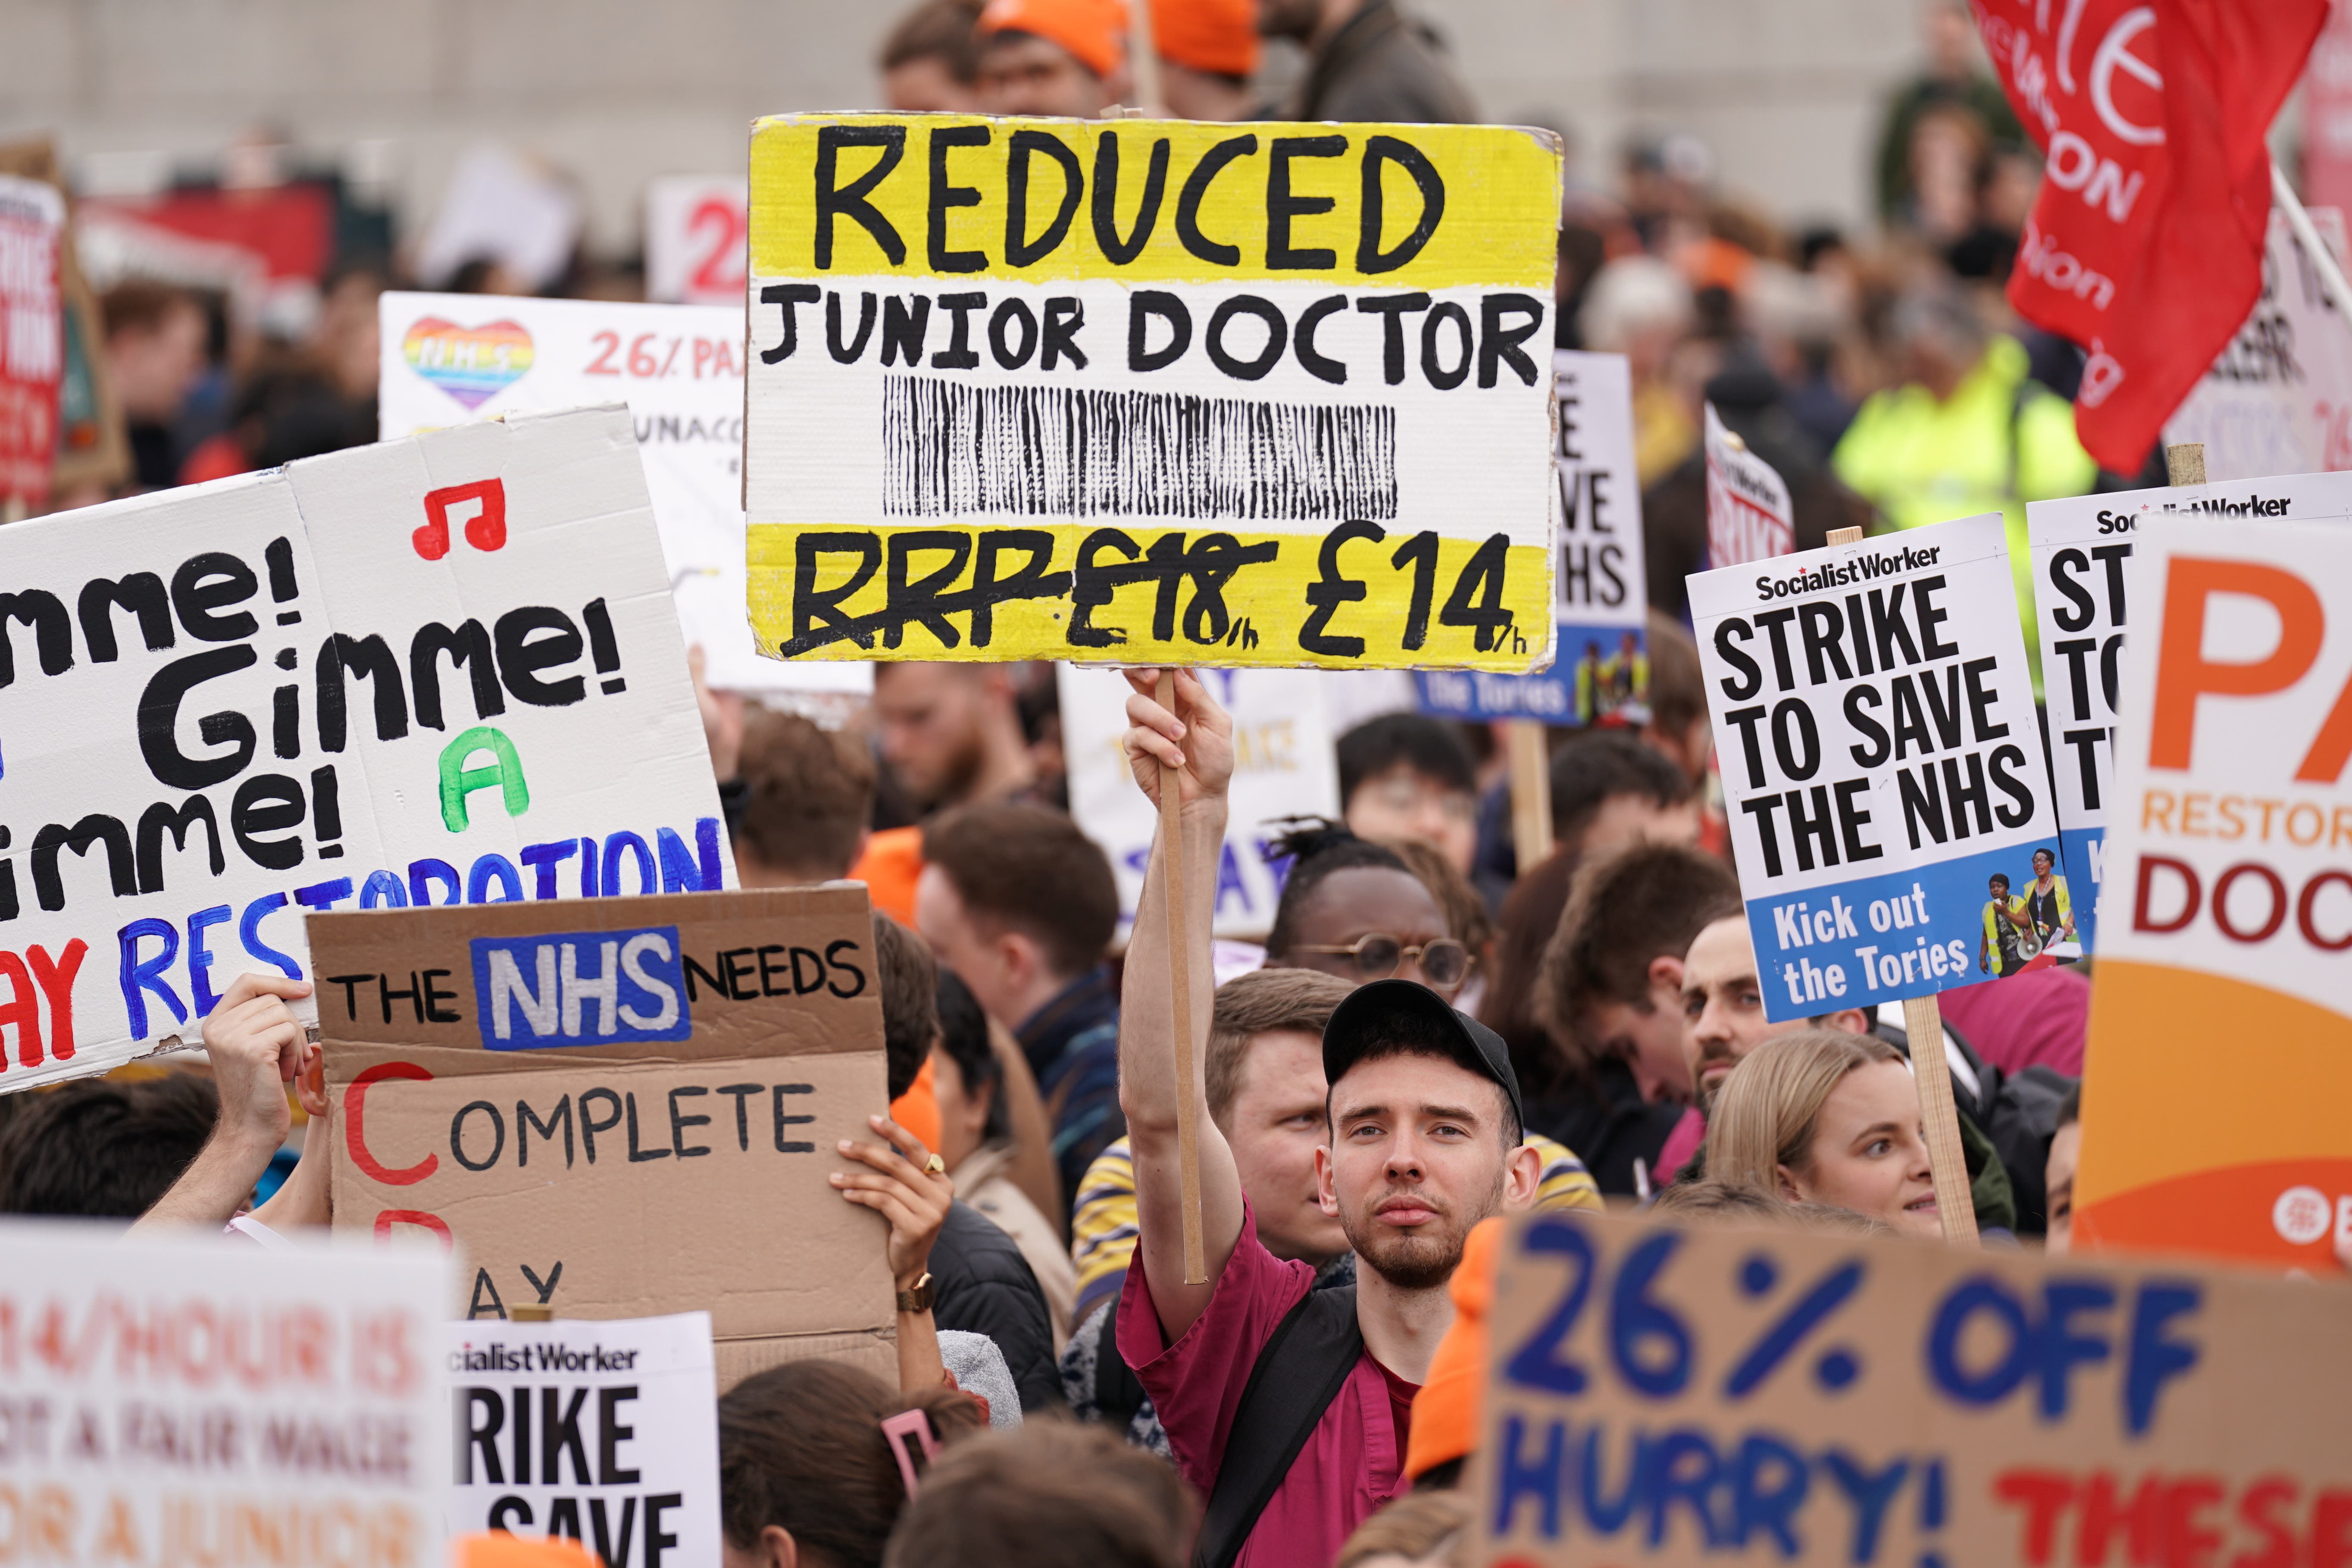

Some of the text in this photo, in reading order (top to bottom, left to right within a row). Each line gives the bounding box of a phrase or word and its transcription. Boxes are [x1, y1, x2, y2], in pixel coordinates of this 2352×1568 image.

[814, 125, 1445, 274] REDUCED
[692, 335, 745, 381] PA
[760, 284, 1544, 390] JUNIOR DOCTOR
[633, 415, 743, 444] UNACC
[0, 536, 302, 687] mme!
[781, 529, 1056, 654] RRP
[1712, 574, 1958, 702] STRIKE
[137, 597, 626, 790] Gimme!
[1723, 655, 2010, 789] TO SAVE
[438, 726, 530, 833] A
[1740, 743, 2035, 879] THE NHS
[2140, 787, 2352, 849] RESTOR
[0, 764, 344, 921] imme!
[2132, 853, 2352, 955] DOC
[1772, 882, 1930, 951] Kick out
[1783, 936, 1970, 1006] the Tories
[0, 938, 89, 1074] AY
[326, 933, 866, 1039] THE NHS NEEDS
[344, 1060, 816, 1186] COMPLETE
[1504, 1216, 2204, 1443] 26% OFF
[451, 1384, 641, 1486] RIKE
[1490, 1415, 1950, 1568] HURRY!
